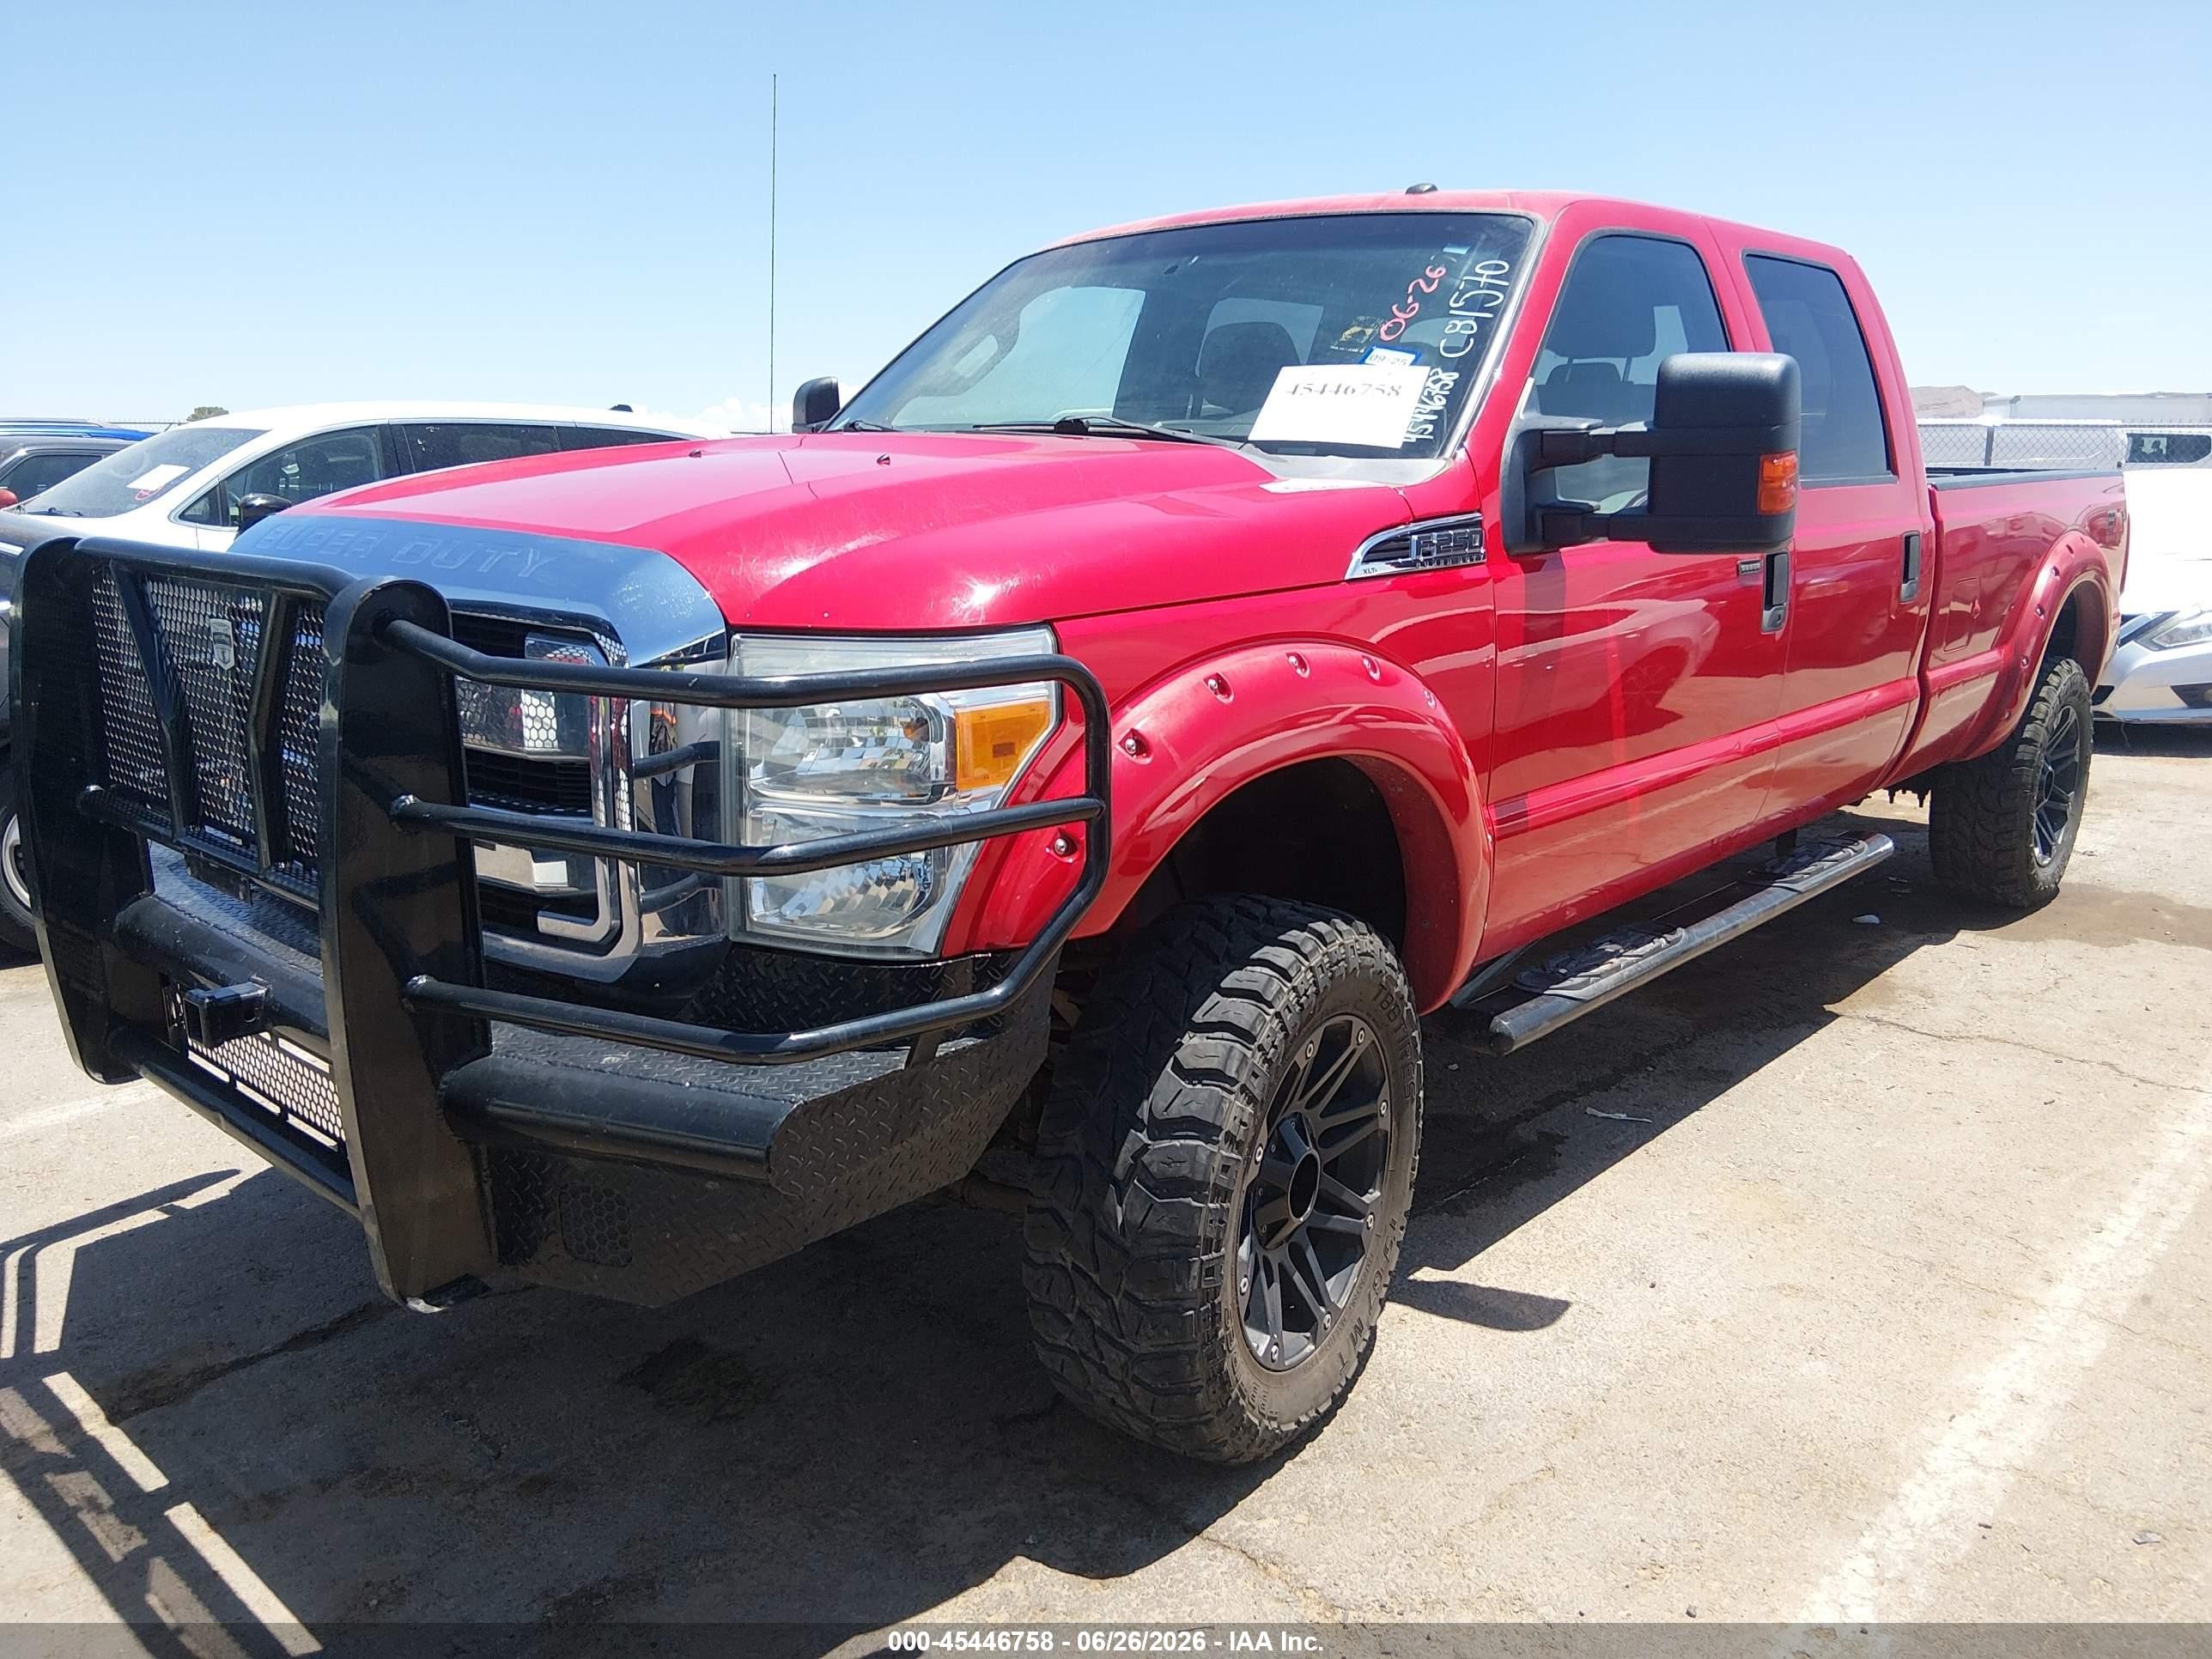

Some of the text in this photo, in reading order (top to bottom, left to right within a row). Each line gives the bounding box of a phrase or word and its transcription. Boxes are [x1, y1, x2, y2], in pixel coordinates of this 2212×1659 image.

[1379, 264, 1447, 342] 06-26
[1286, 383, 1402, 398] 45446758
[391, 535, 558, 578] DUTY
[1363, 568, 1376, 576] XLT
